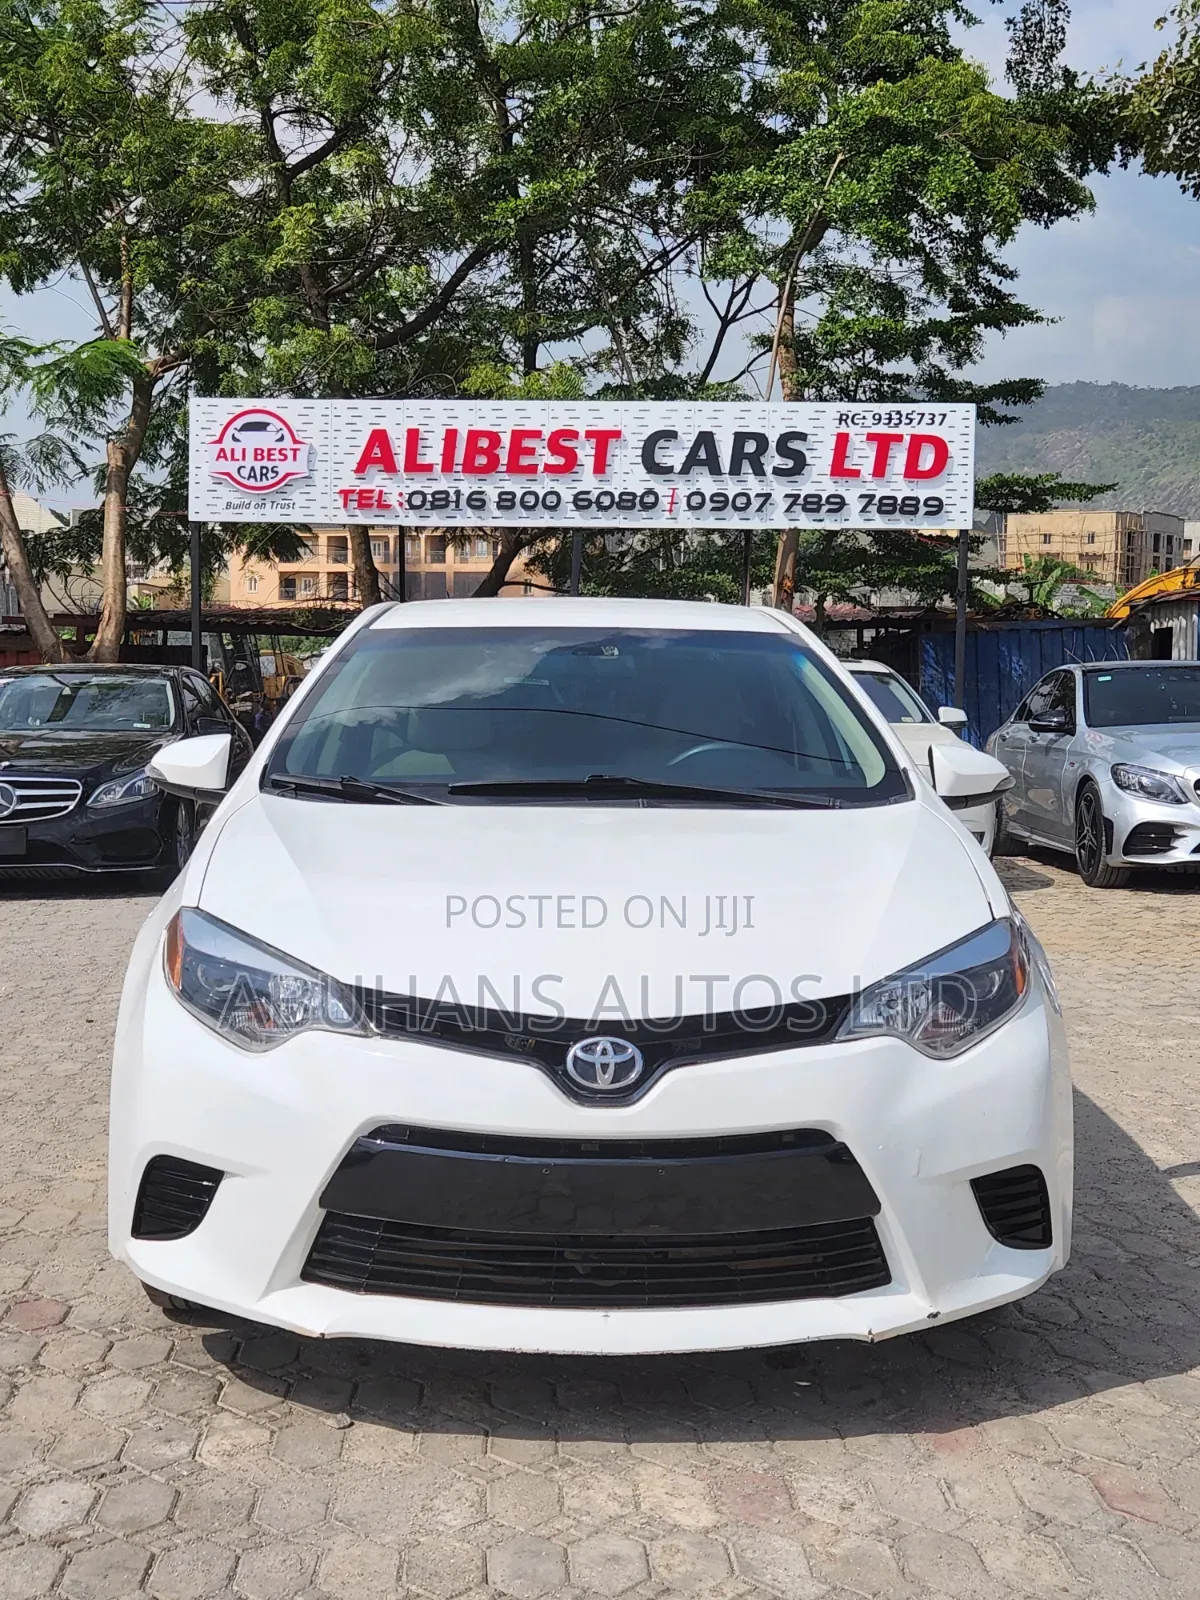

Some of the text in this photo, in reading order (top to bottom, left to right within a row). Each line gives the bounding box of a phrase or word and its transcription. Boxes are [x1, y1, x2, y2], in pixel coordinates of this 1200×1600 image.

[871, 412, 948, 427] 9335737
[215, 447, 301, 463] ALI BEST
[353, 427, 949, 480] ALIBEST CARS LTD
[237, 465, 280, 483] CARS
[225, 500, 296, 510] Build on Trust
[406, 489, 487, 511] 0816
[496, 490, 562, 512] 800
[572, 490, 660, 512] 6080
[685, 491, 773, 514] 0907
[782, 493, 847, 515] 789
[858, 493, 945, 516] 7889
